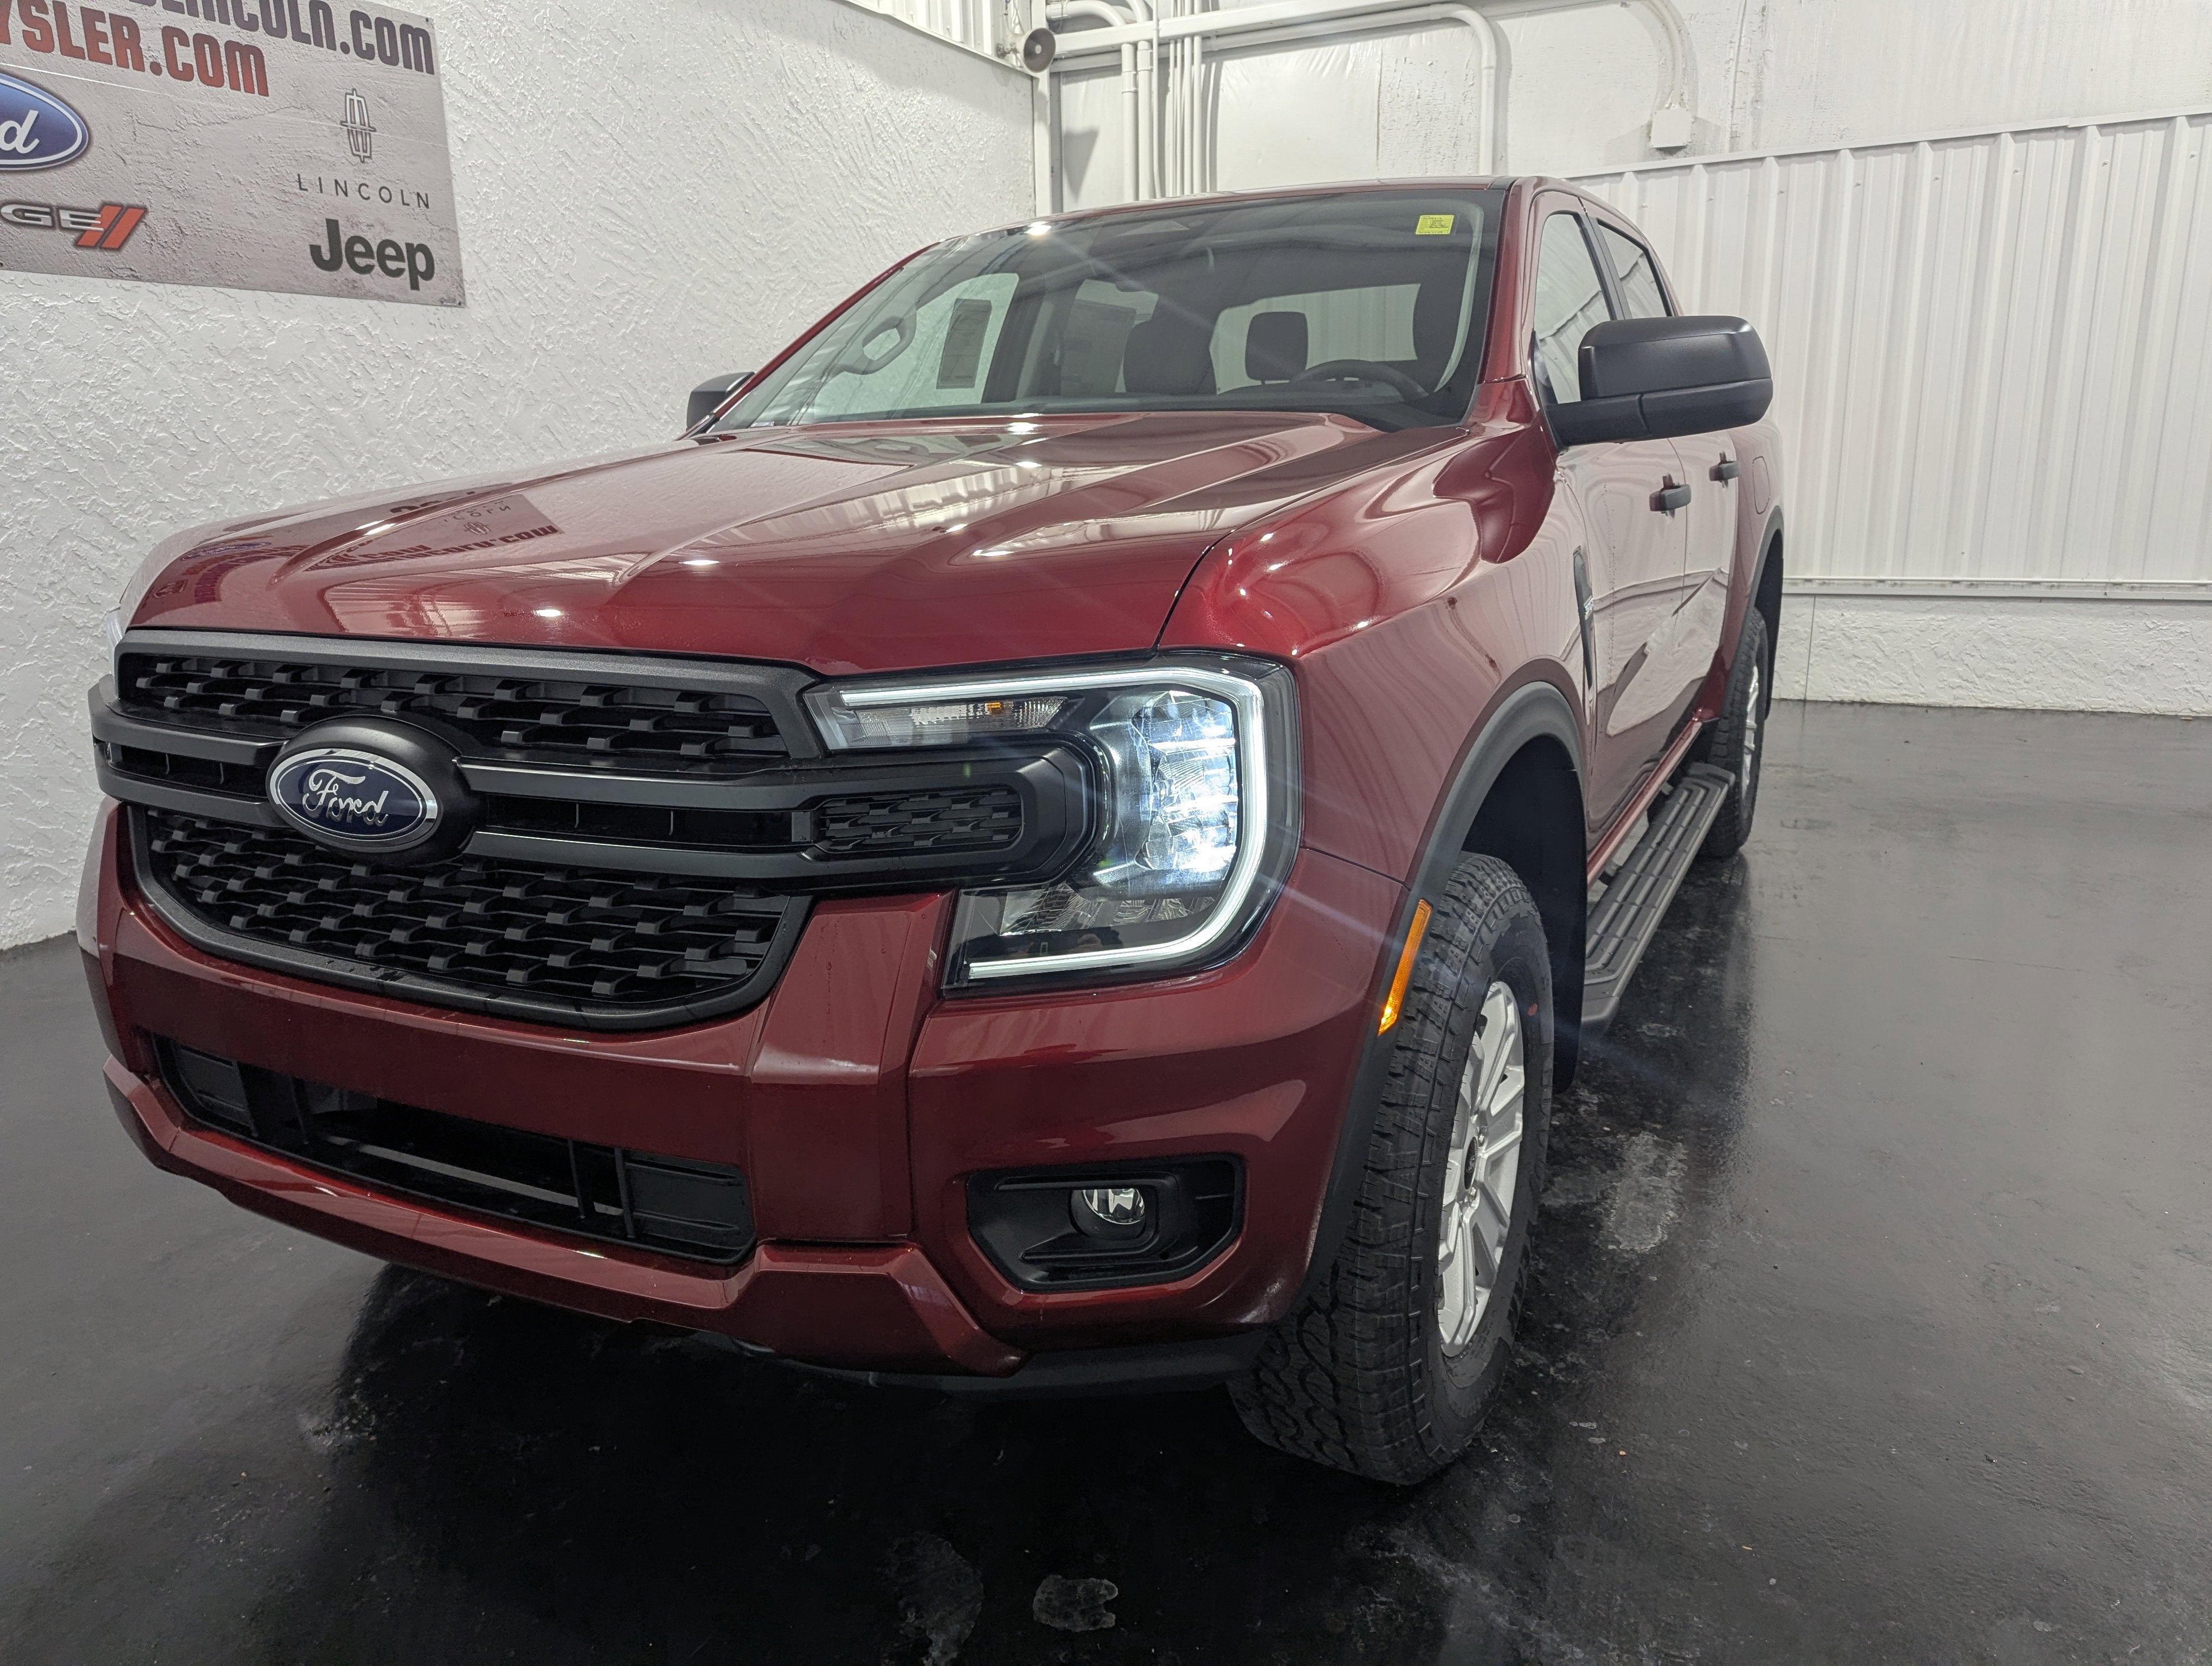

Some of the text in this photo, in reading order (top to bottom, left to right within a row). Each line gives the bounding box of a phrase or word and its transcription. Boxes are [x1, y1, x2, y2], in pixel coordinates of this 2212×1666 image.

[297, 174, 429, 209] LINCOLN
[310, 218, 435, 291] Jeep
[303, 768, 389, 827] Ford
